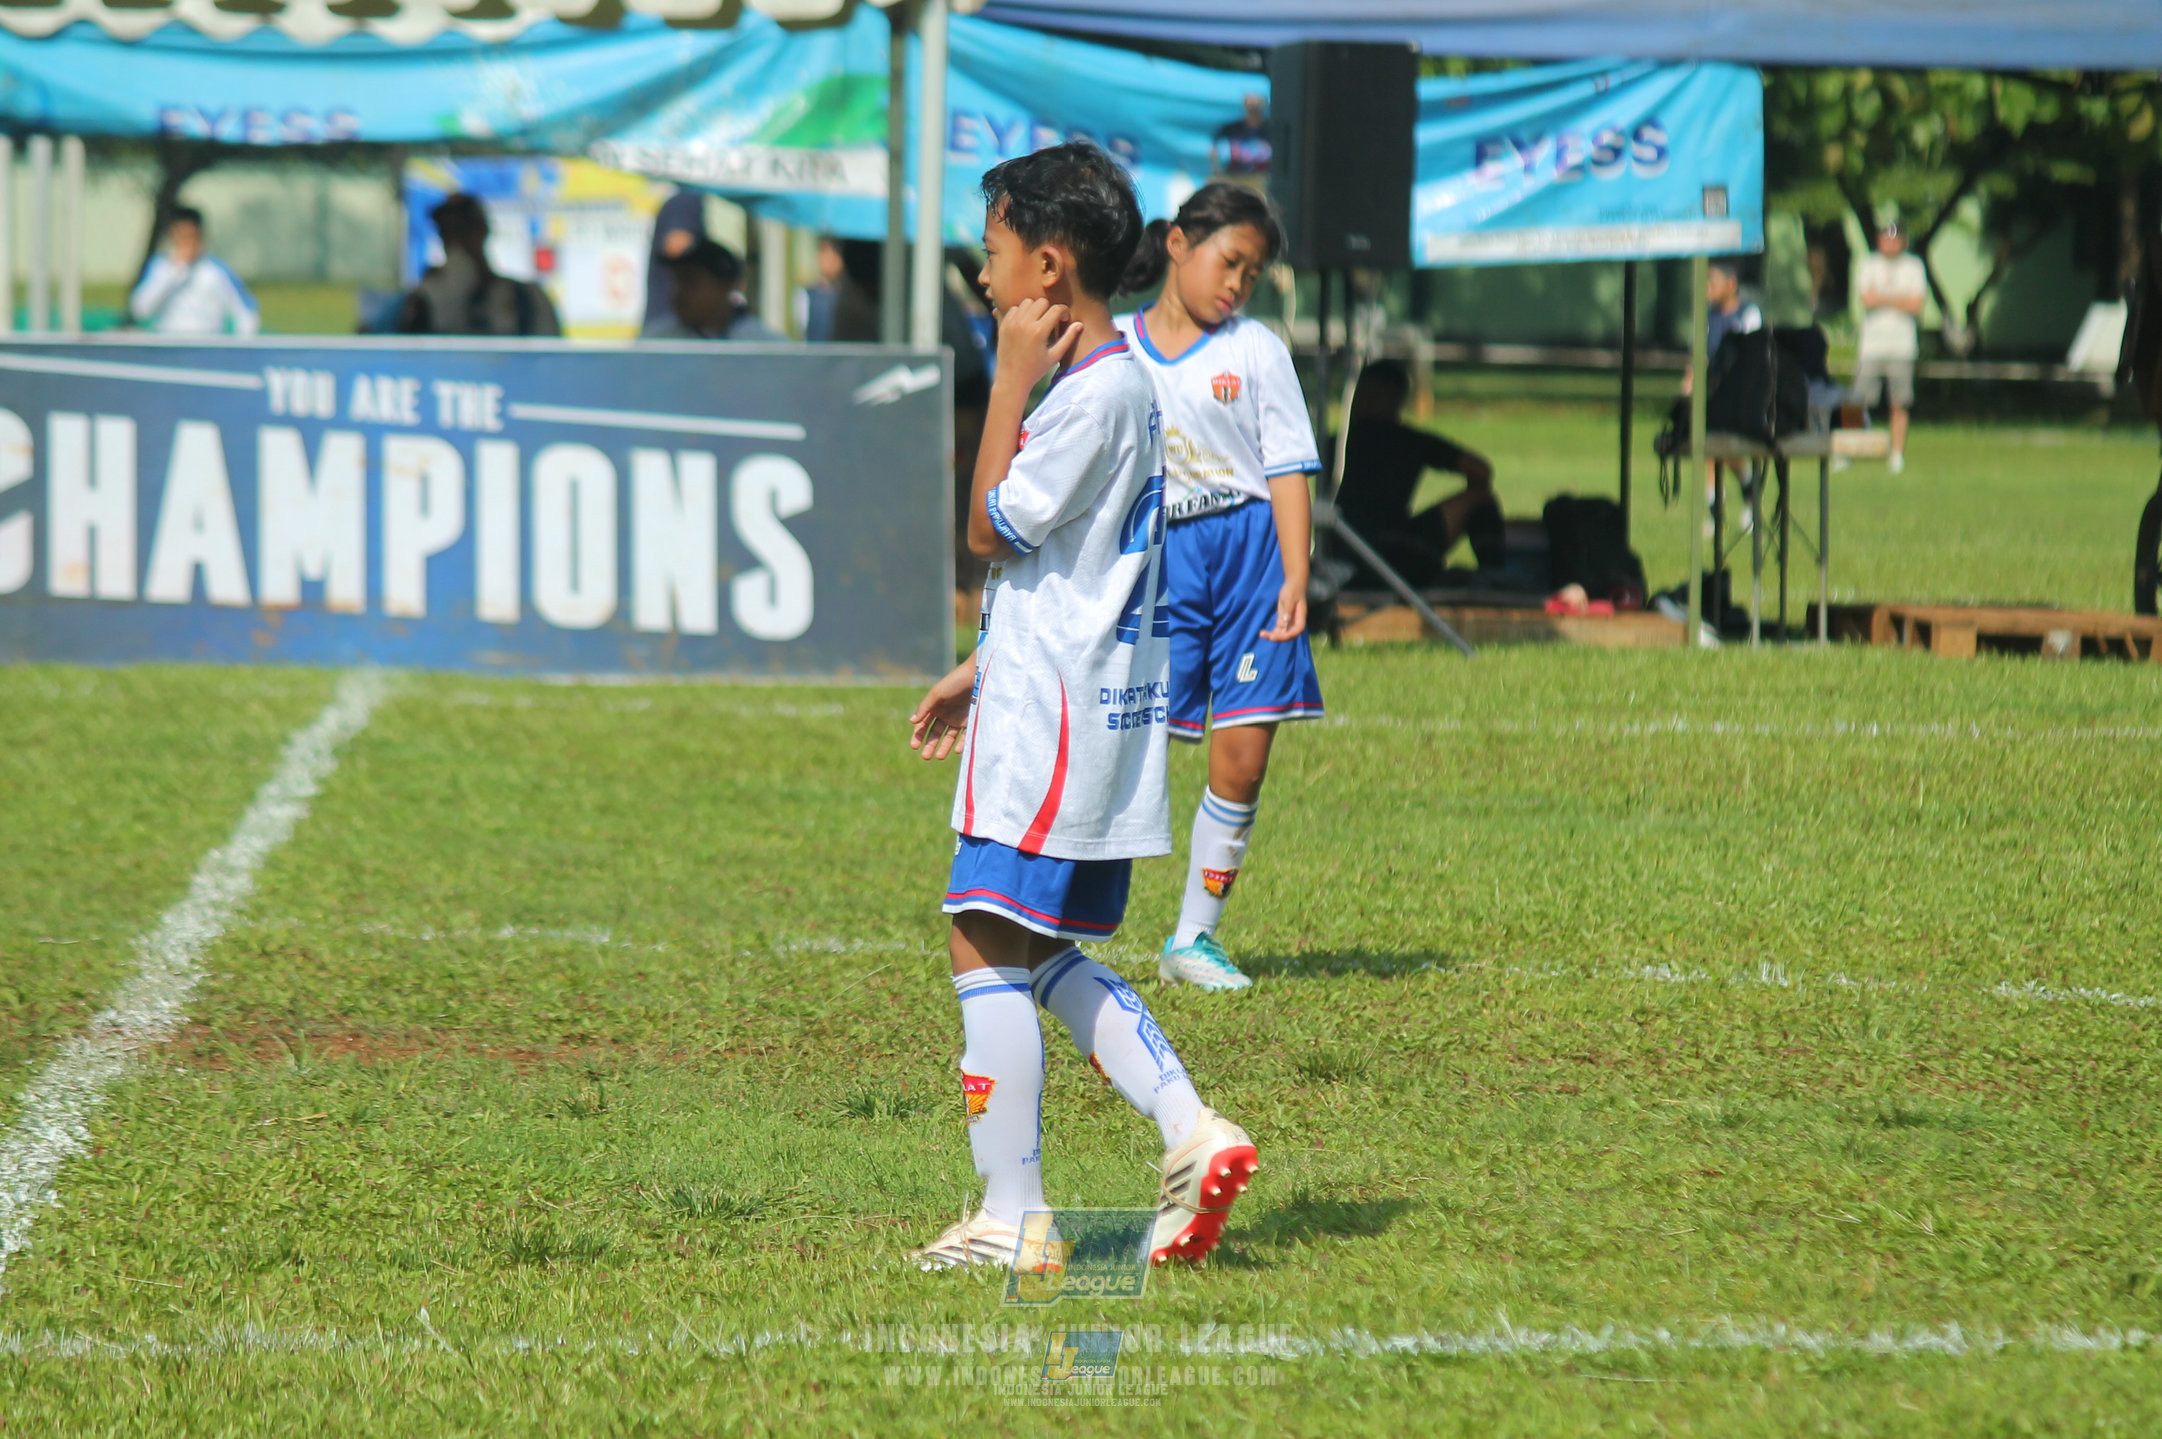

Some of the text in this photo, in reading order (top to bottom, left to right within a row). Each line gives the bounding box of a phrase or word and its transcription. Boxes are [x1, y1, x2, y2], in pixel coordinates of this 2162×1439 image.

[1473, 118, 1671, 185] EYESS
[263, 365, 505, 434] YOU ARE THE
